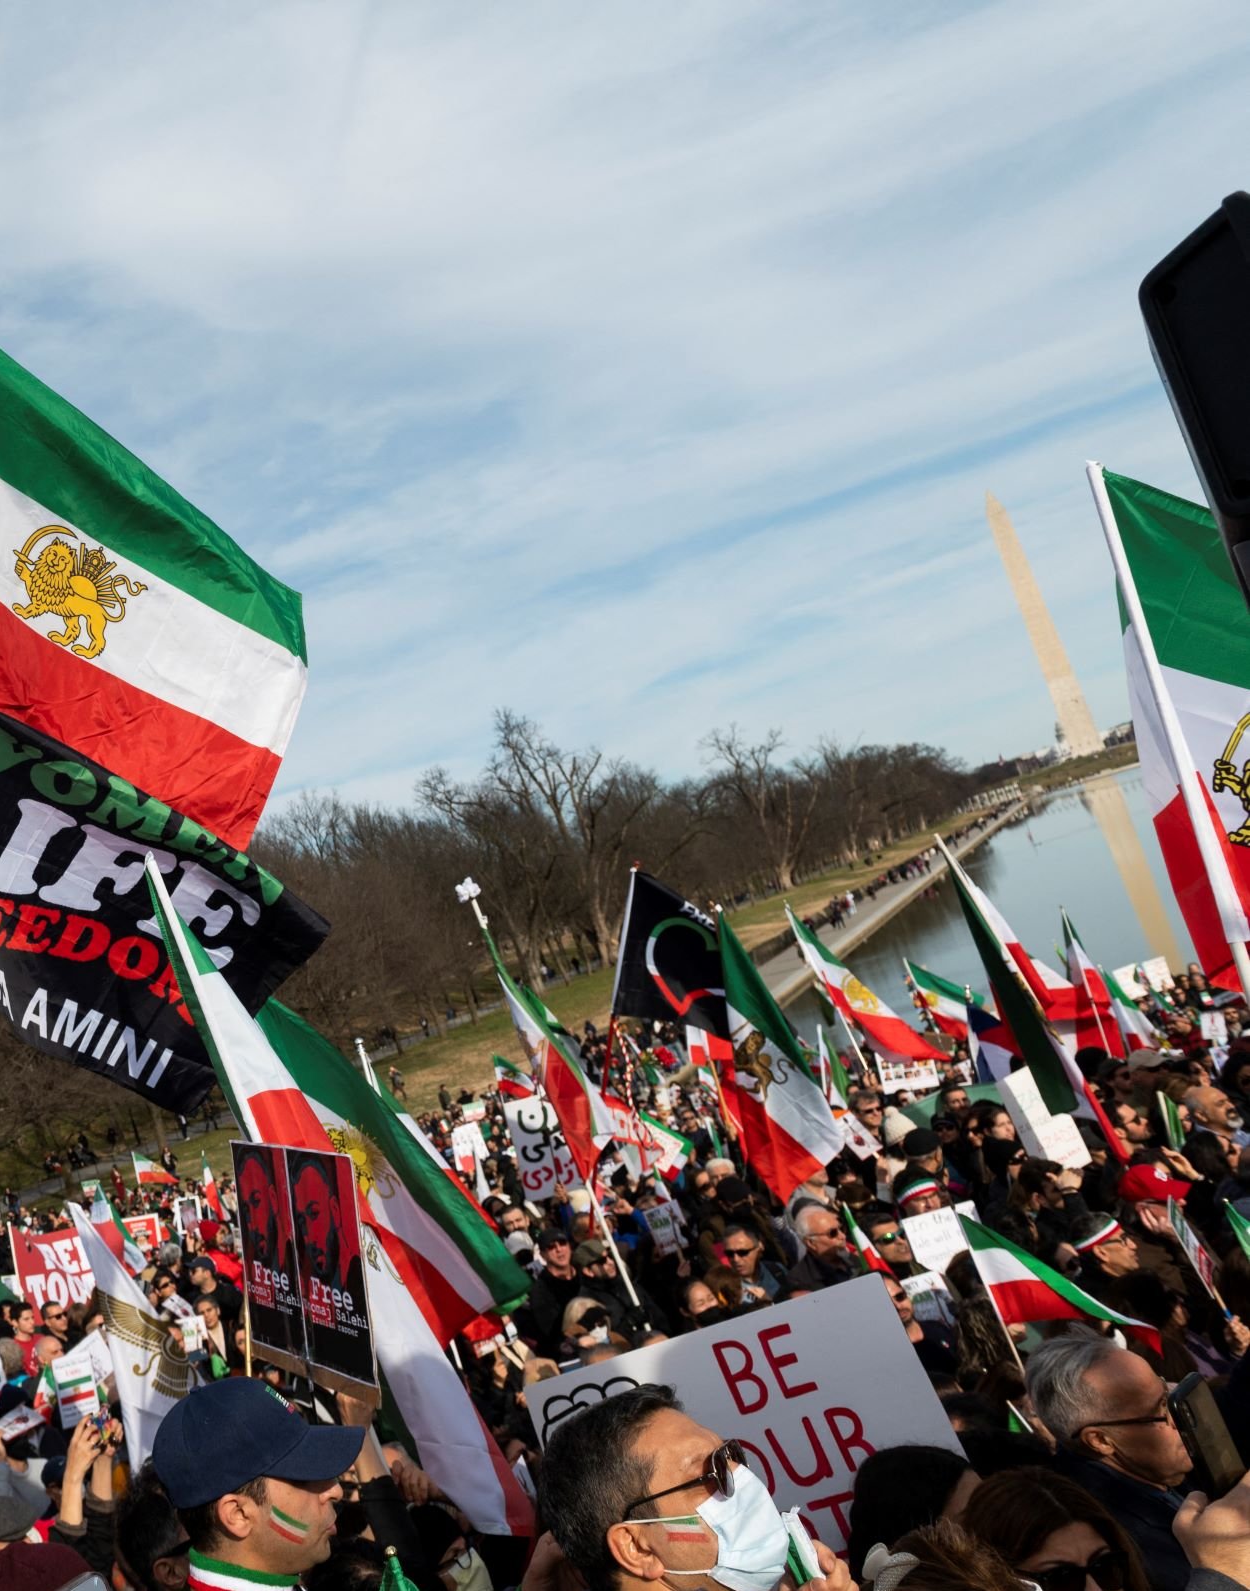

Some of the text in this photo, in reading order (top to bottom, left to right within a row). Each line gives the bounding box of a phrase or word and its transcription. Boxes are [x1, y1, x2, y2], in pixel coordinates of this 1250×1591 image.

[21, 998, 173, 1088] AMINI
[523, 1156, 575, 1191] زادی
[253, 1260, 289, 1291] Free
[310, 1276, 353, 1311] Free
[336, 1309, 368, 1330] Salehi
[712, 1323, 818, 1415] BE
